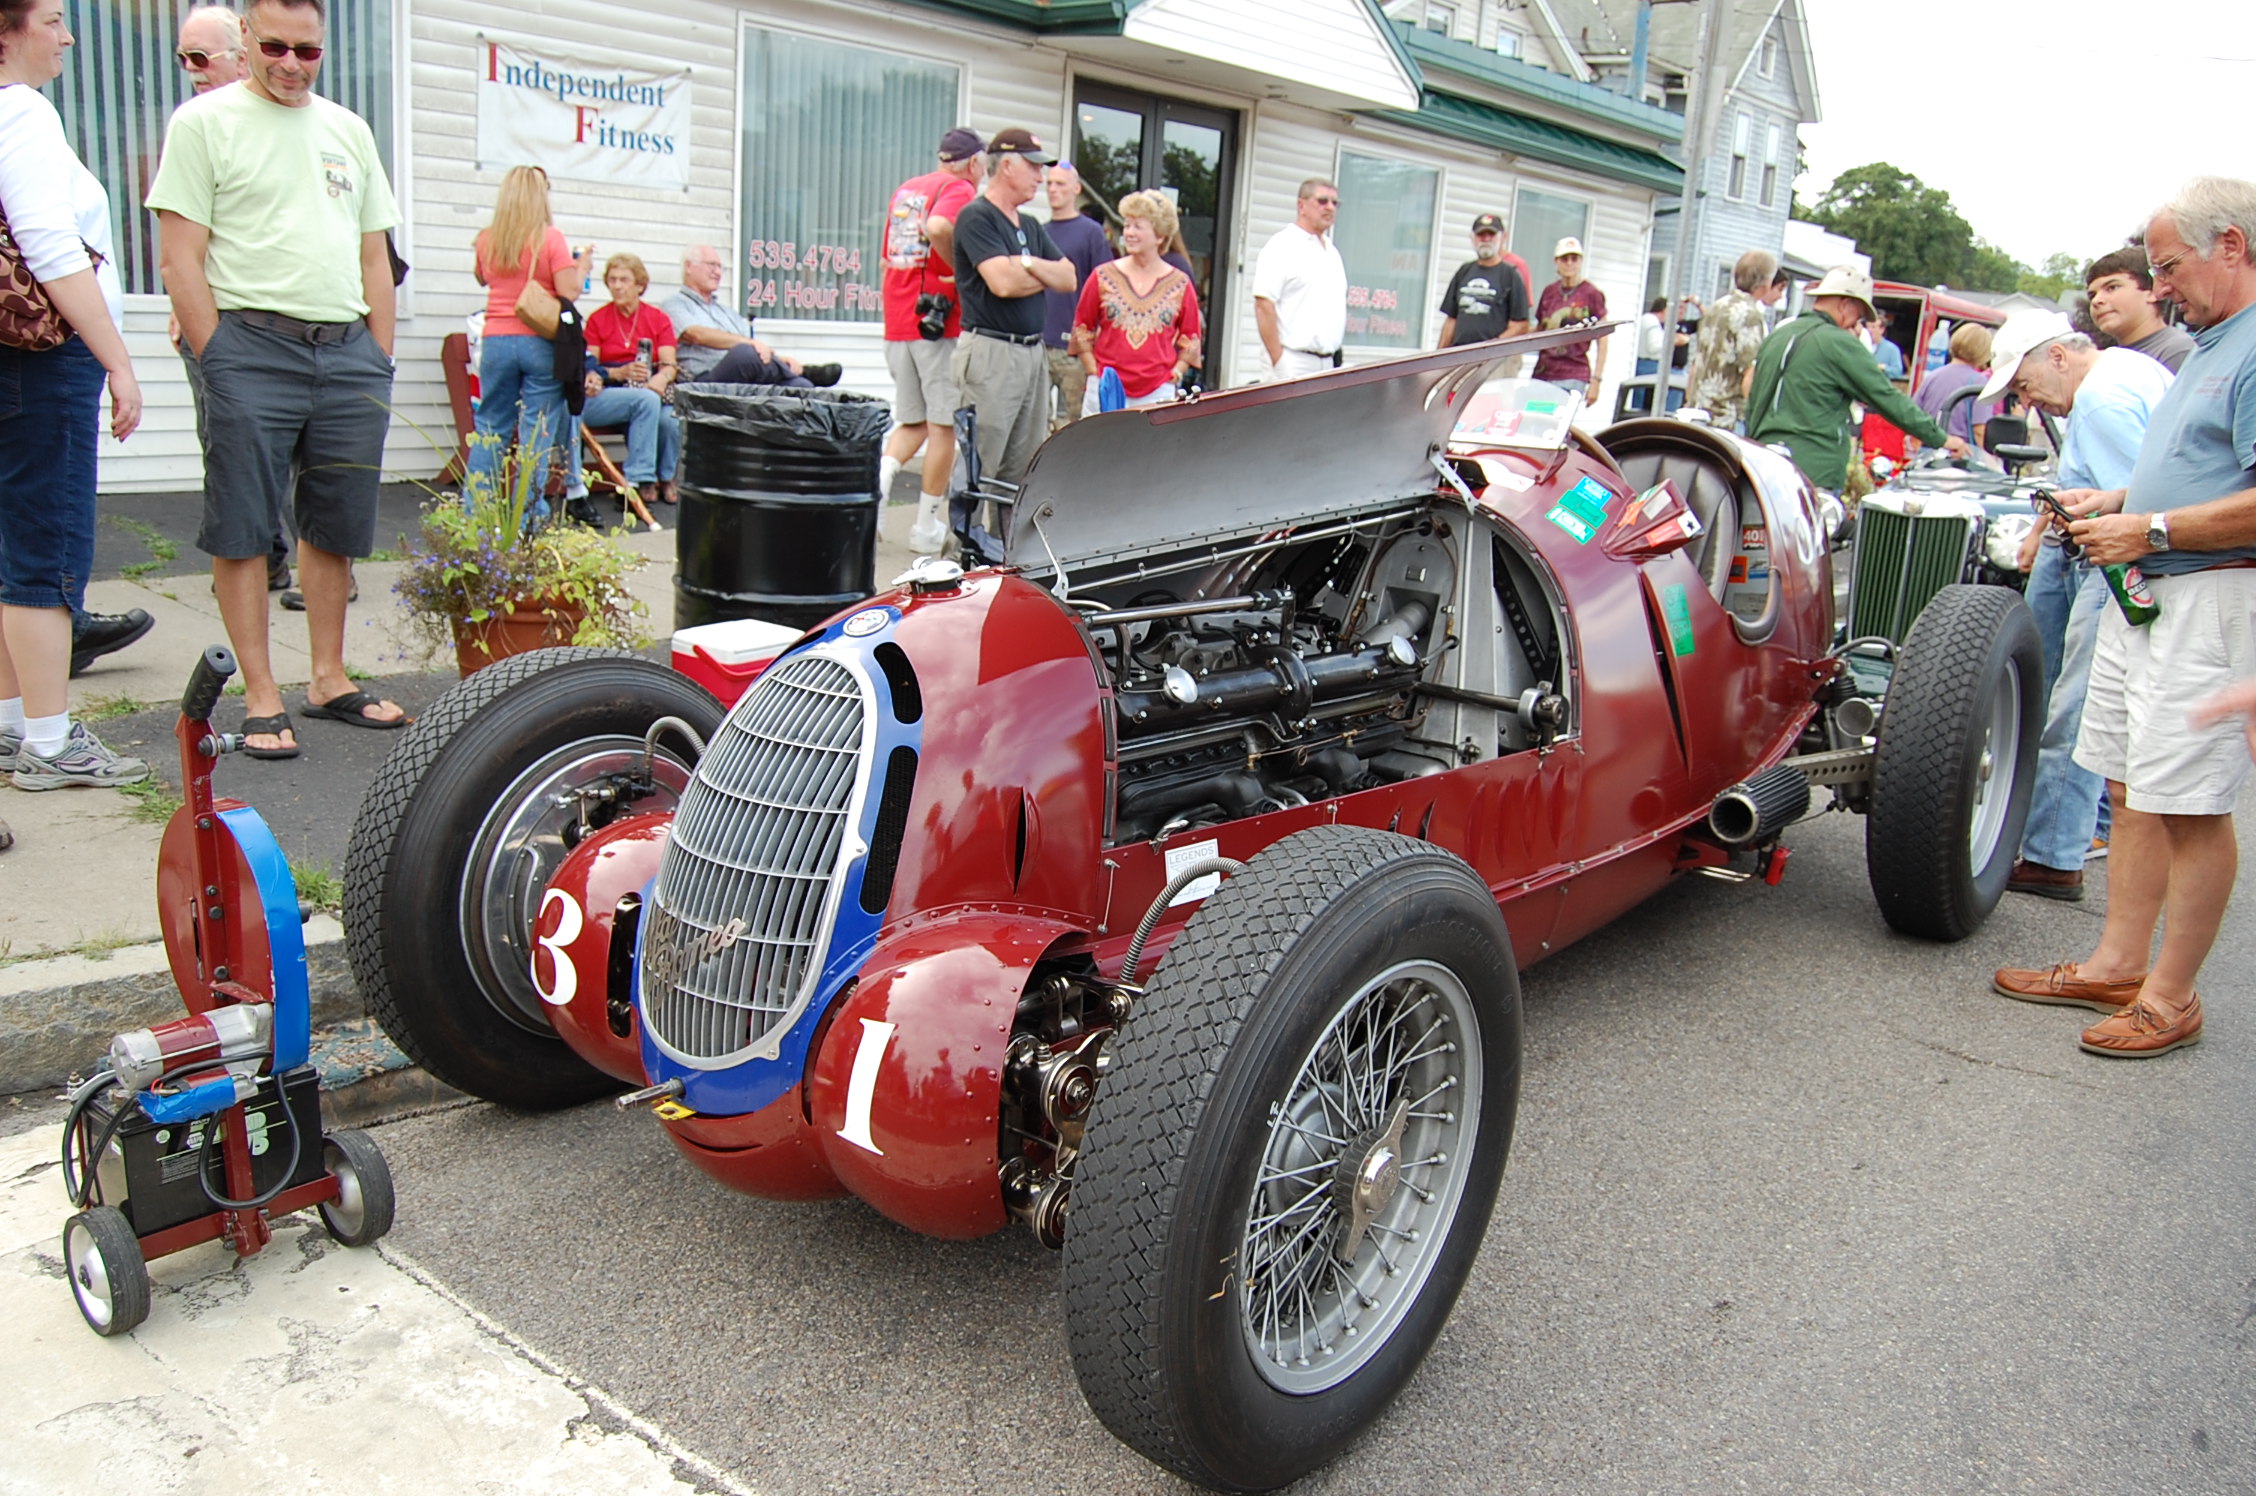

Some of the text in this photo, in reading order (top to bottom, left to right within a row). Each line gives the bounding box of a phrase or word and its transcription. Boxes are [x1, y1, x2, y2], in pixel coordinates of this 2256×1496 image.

[487, 42, 666, 107] Independent
[574, 105, 675, 155] Fitness
[749, 239, 861, 274] 535.4764
[747, 278, 883, 312] 24 Hour Fitn
[1345, 314, 1367, 333] our
[1169, 845, 1215, 865] LEGENDS
[531, 887, 583, 1006] 3
[652, 917, 746, 1010] Romeo
[836, 1017, 896, 1157] 1
